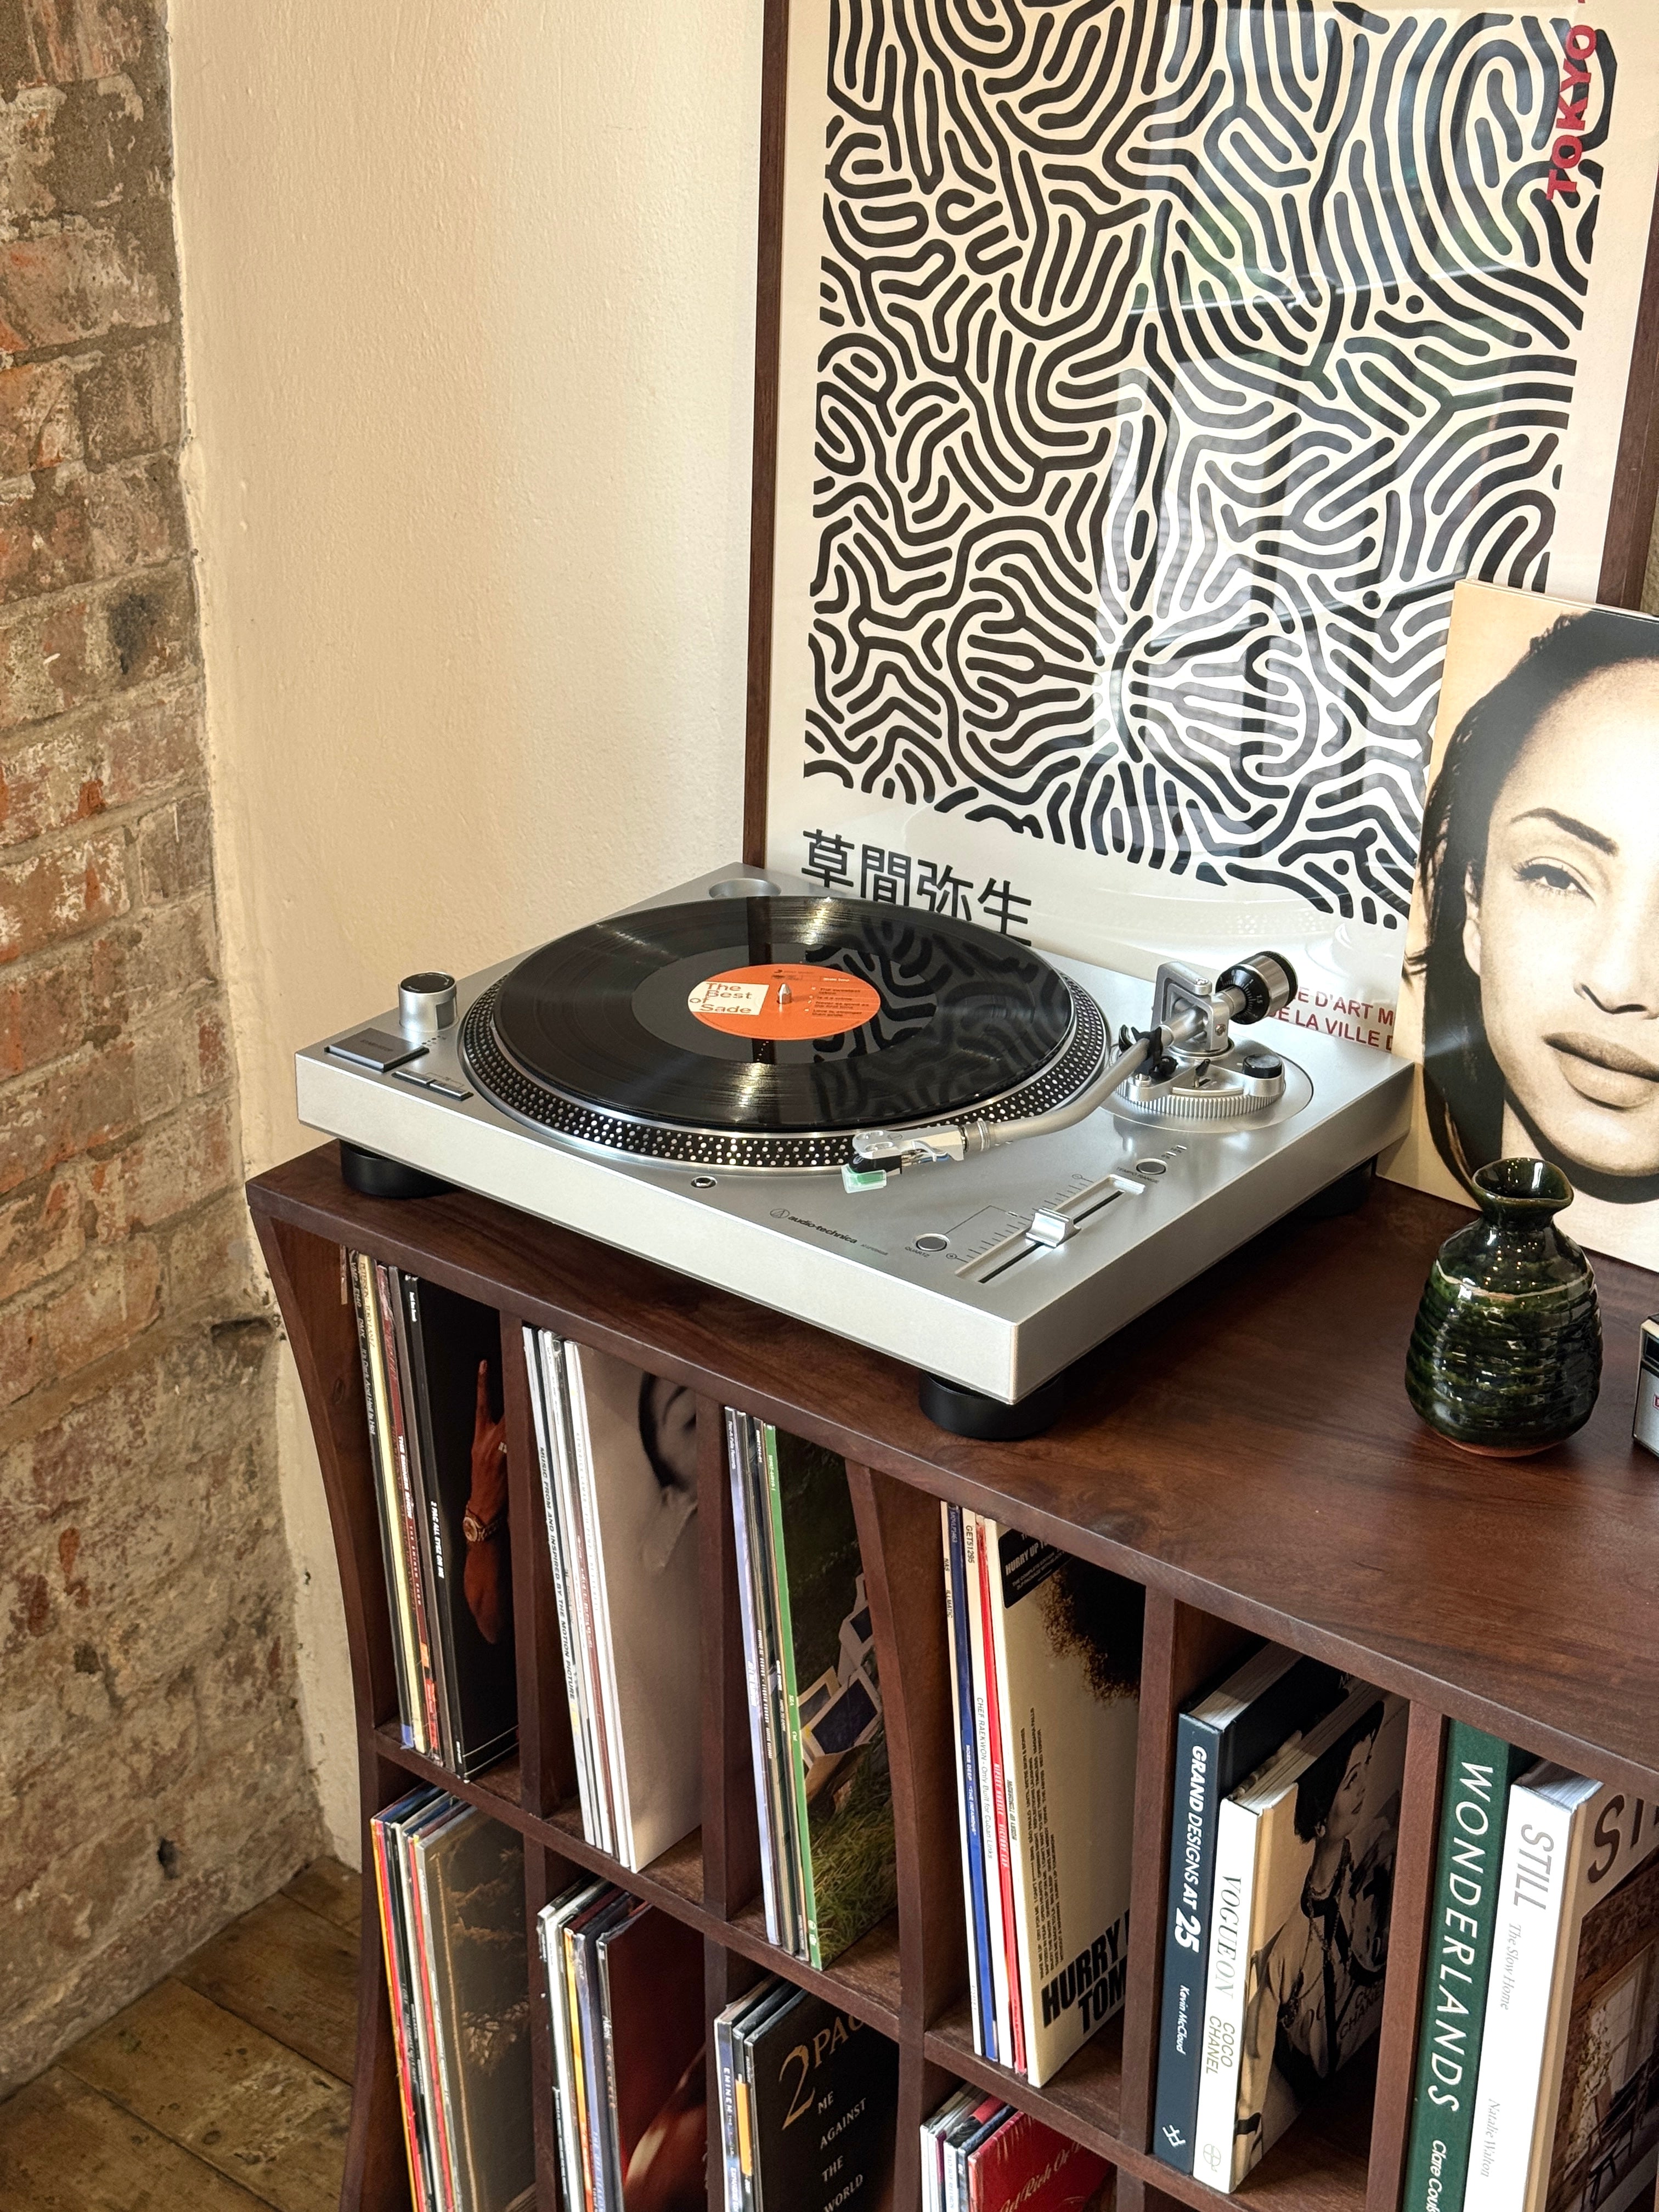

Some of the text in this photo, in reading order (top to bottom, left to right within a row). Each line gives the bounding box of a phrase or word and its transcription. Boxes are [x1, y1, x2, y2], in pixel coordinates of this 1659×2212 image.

[1545, 25, 1596, 200] TOKYO
[802, 829, 1031, 946] 草間弥生
[707, 983, 741, 991] The
[707, 991, 752, 1000] Best
[1315, 991, 1374, 1019] D'ART
[699, 1004, 752, 1014] Sade
[1295, 1010, 1319, 1030] LA
[1325, 1017, 1379, 1047] VILLE
[788, 1215, 857, 1244] audio-technica
[905, 1246, 930, 1258] QUARTZ
[357, 1317, 365, 1338] DMX
[539, 1447, 548, 1478] MUSIC
[404, 1491, 413, 1519] SHOW
[542, 1480, 552, 1509] FROM
[549, 1534, 561, 1580] INSPIRED
[1005, 1542, 1039, 1576] HURRY UP
[556, 1583, 562, 1596] BY
[560, 1620, 570, 1657] MOTION
[565, 1660, 575, 1700] PICTURE
[978, 1720, 986, 1760] RAEKWON
[1174, 1745, 1207, 1954] GRAND DESIGNS AT 25
[1513, 1823, 1554, 1911] STILL
[1213, 1875, 1242, 1999] VOGUE ON
[1427, 1761, 1493, 2112] WONDERLANDS
[1042, 1922, 1121, 2029] HURRY
[1500, 1923, 1522, 2011] The Slow Home
[1175, 1984, 1191, 2055] Kevin McCloud
[1205, 2015, 1223, 2075] CHANEL
[1220, 2021, 1236, 2069] COCO
[720, 2067, 735, 2113] EMINEM
[820, 2097, 866, 2150] AGAINST
[1480, 2097, 1501, 2178] Natalie Walton
[821, 2155, 843, 2182] THE
[1430, 2140, 1447, 2177] Clare
[823, 2174, 864, 2212] WORLD
[1020, 2163, 1052, 2201] Rich
